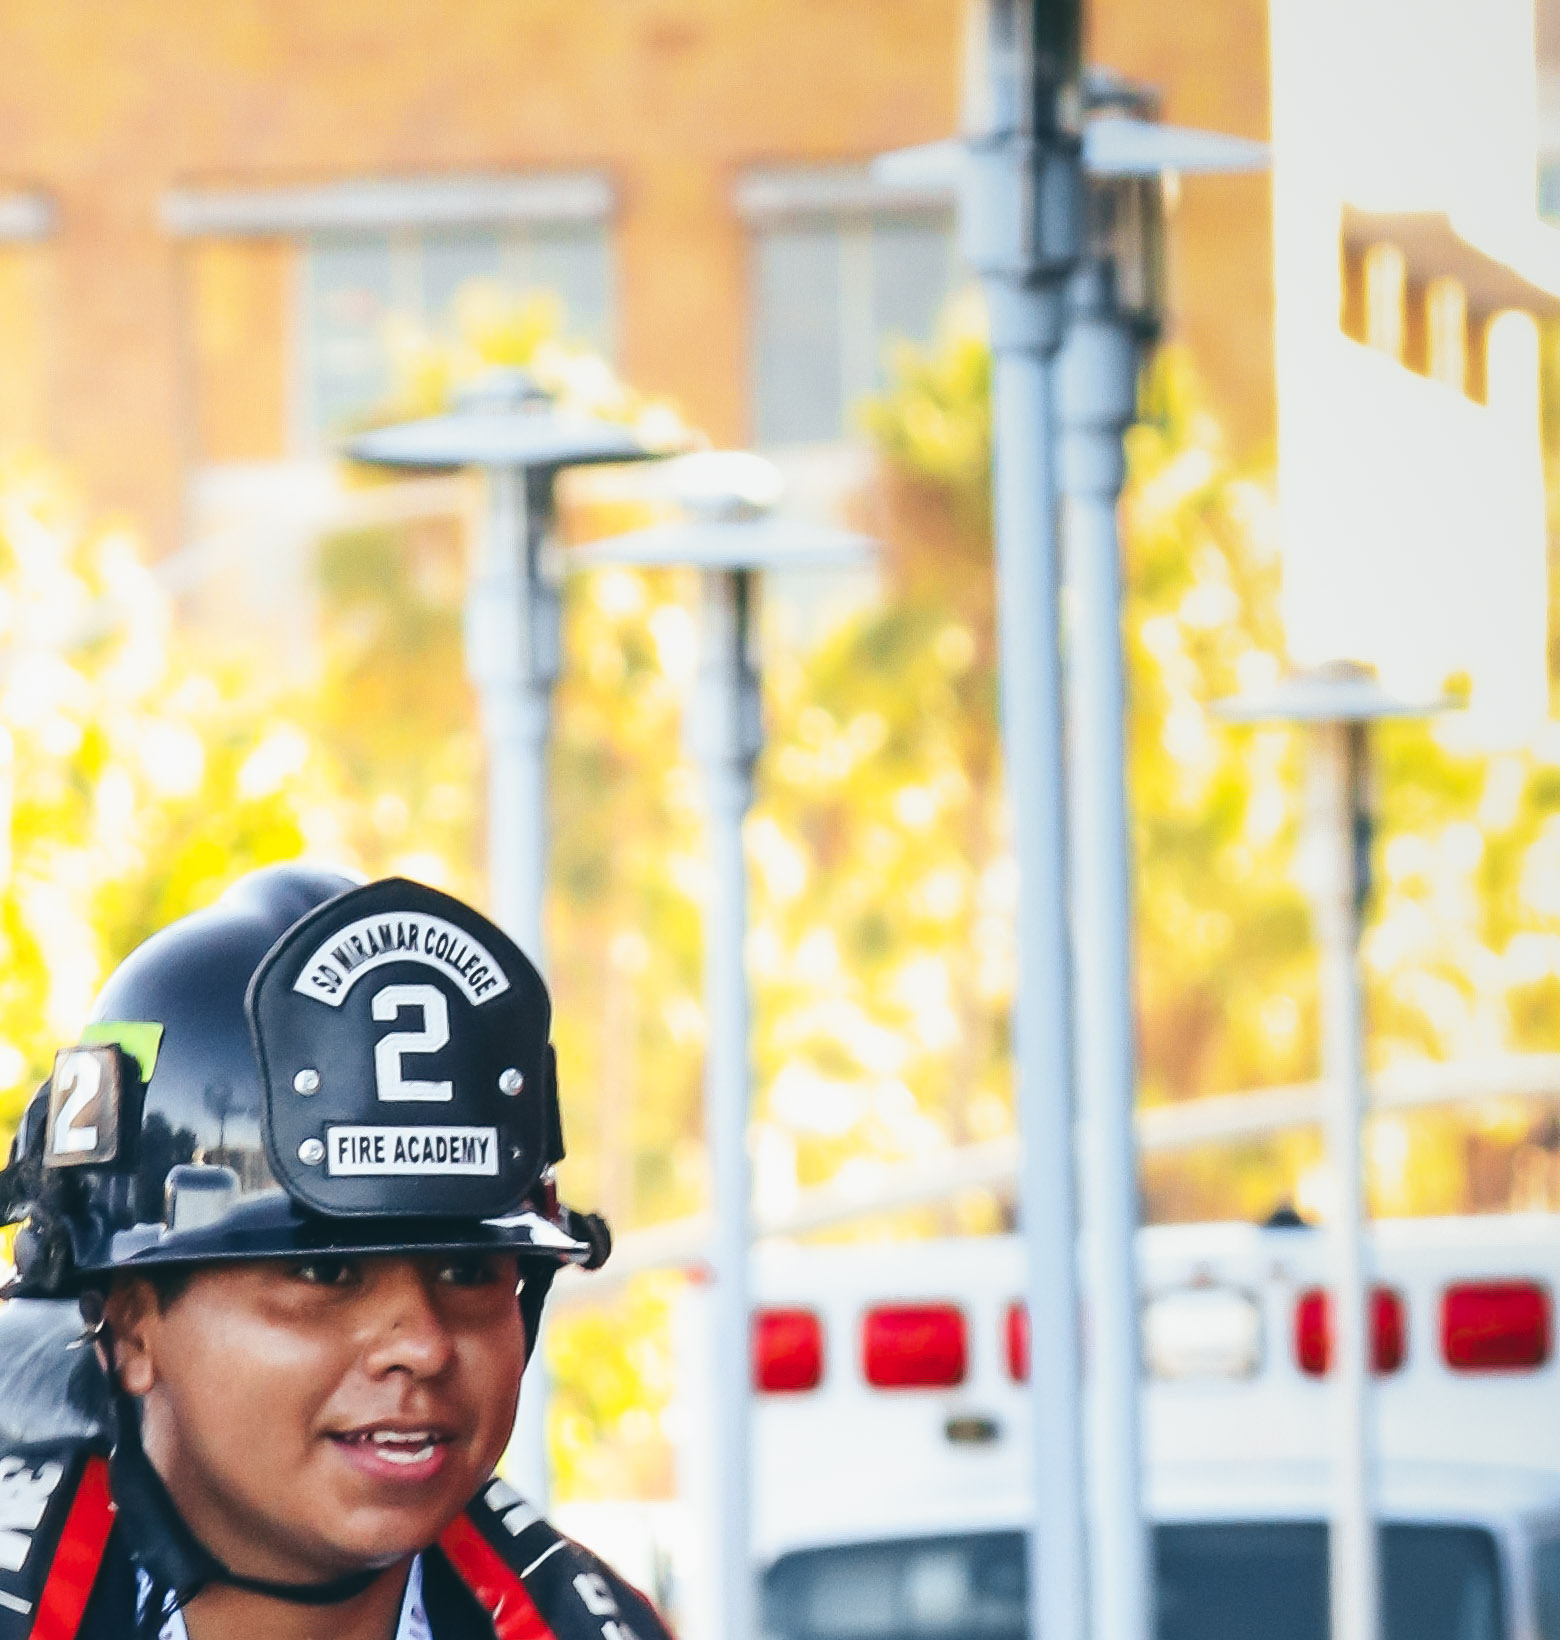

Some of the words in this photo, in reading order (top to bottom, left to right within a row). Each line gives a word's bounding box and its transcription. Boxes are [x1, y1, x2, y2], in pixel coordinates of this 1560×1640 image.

[330, 922, 419, 974] MIRAMAR
[424, 927, 498, 997] COLLEGE
[371, 984, 453, 1101] 2
[53, 1050, 101, 1155] 2
[338, 1136, 385, 1164] FIRE
[393, 1136, 489, 1164] ACADEMY
